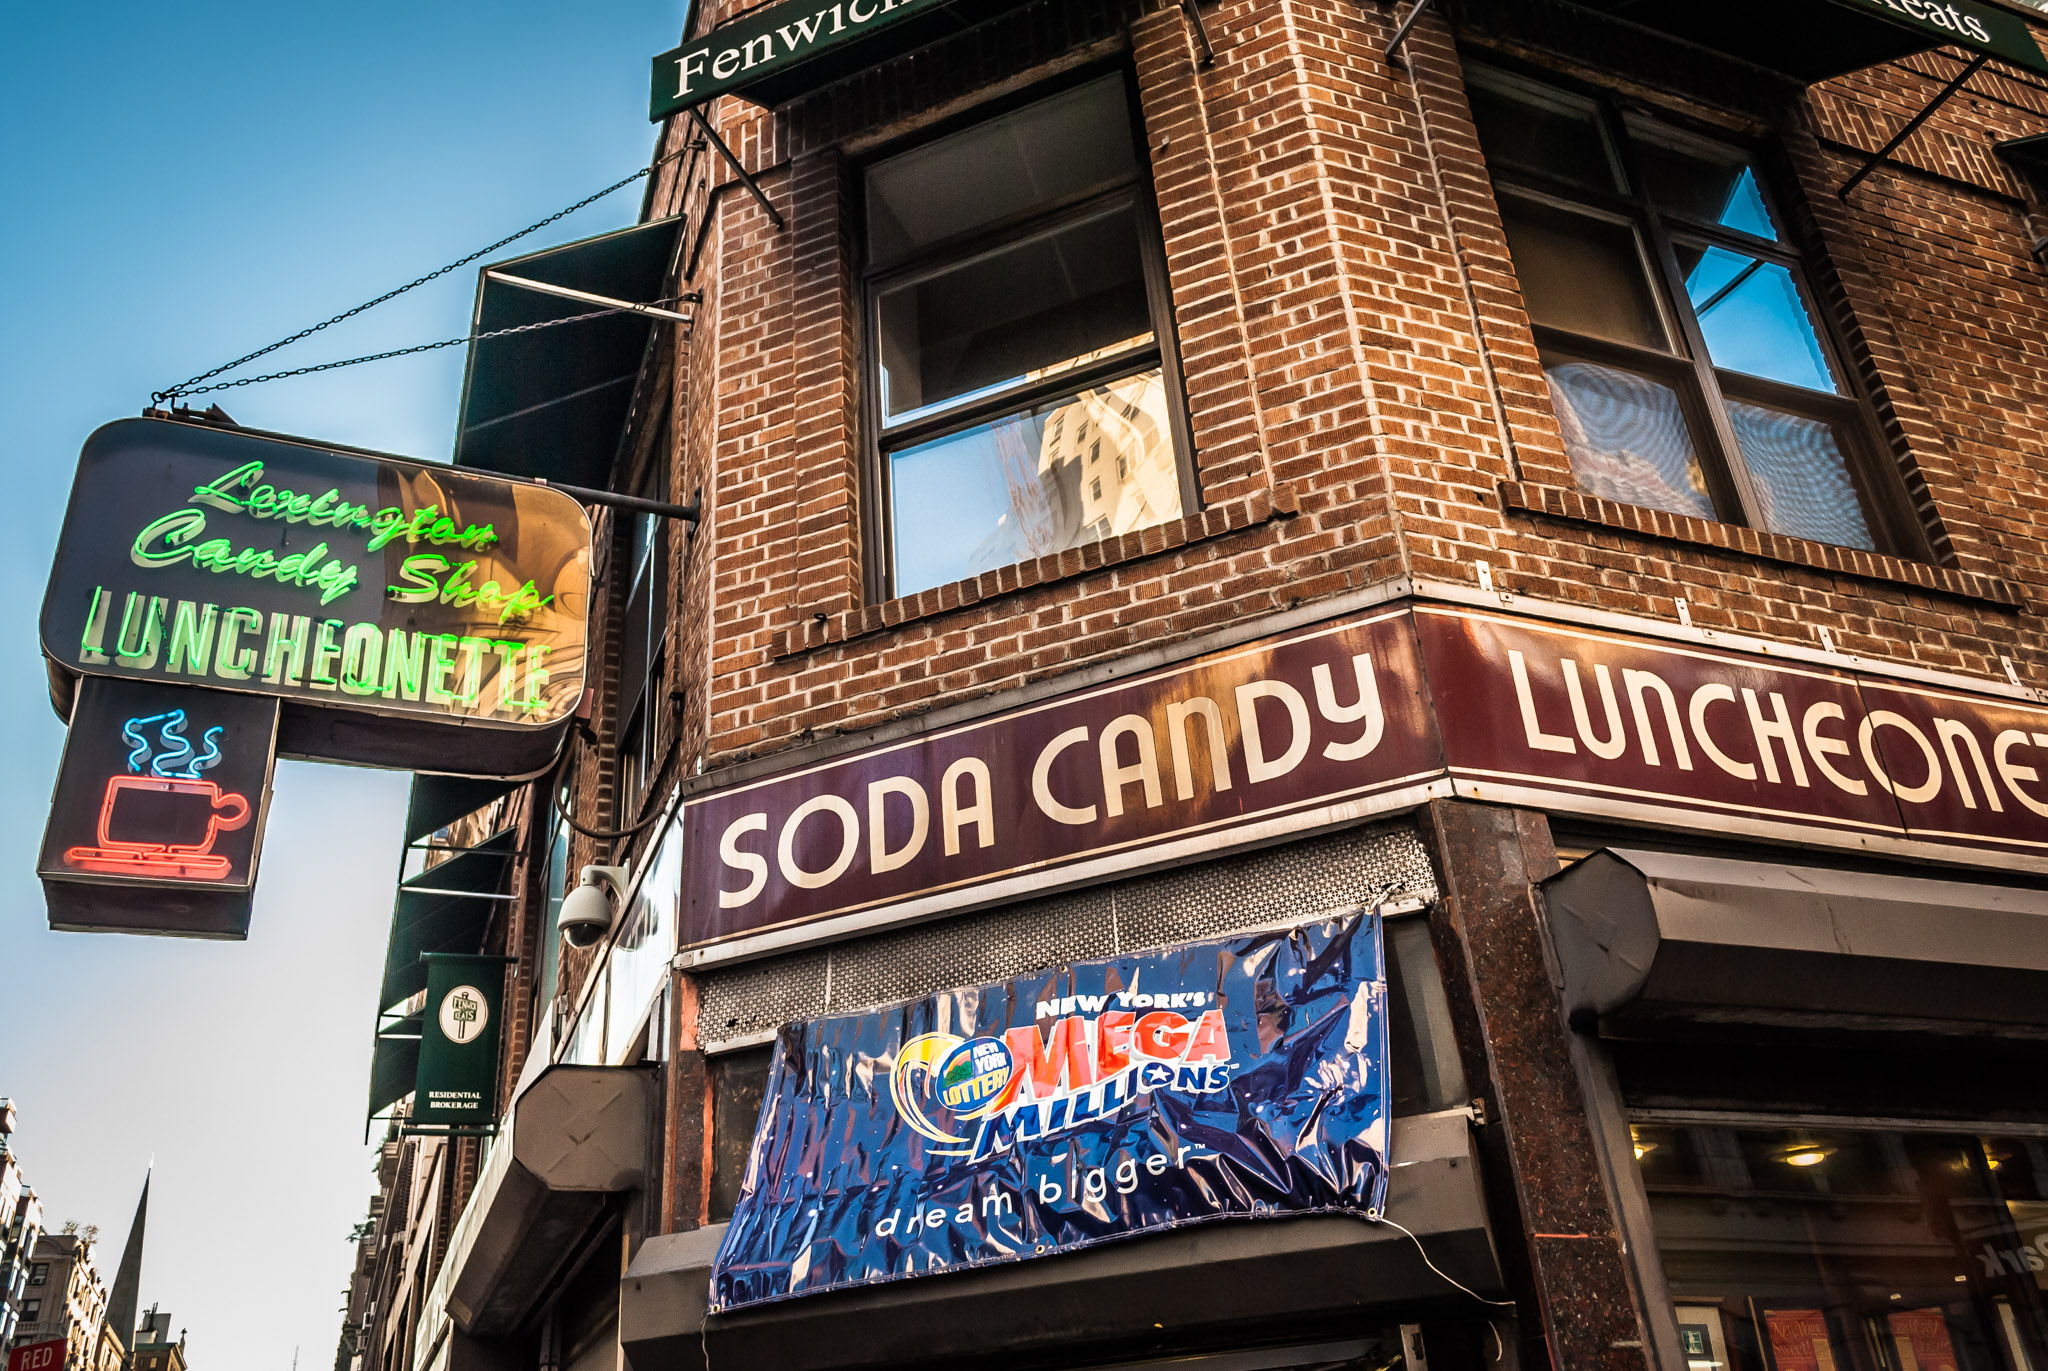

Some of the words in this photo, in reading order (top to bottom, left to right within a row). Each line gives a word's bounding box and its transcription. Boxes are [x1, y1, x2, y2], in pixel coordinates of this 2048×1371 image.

[672, 0, 912, 99] Fenwic
[189, 461, 498, 551] Lexington
[131, 508, 358, 605] Candy
[388, 554, 554, 624] Shop
[79, 585, 552, 713] LUNCHEONETTE
[718, 756, 996, 910] SODA
[972, 1042, 999, 1059] NEW
[1036, 995, 1108, 1020] NEW
[1116, 991, 1206, 1009] YORK'S
[429, 1091, 482, 1100] RESIDENTIAL
[430, 1101, 479, 1110] BROKERAGE
[943, 1066, 1010, 1106] LOTTERY
[975, 1052, 1007, 1075] YORK
[990, 1008, 1231, 1114] MEGA
[968, 1061, 1230, 1166] MILLIONS
[875, 1190, 1013, 1237] dream
[1039, 1145, 1192, 1206] bigger
[21, 1347, 53, 1371] RED
